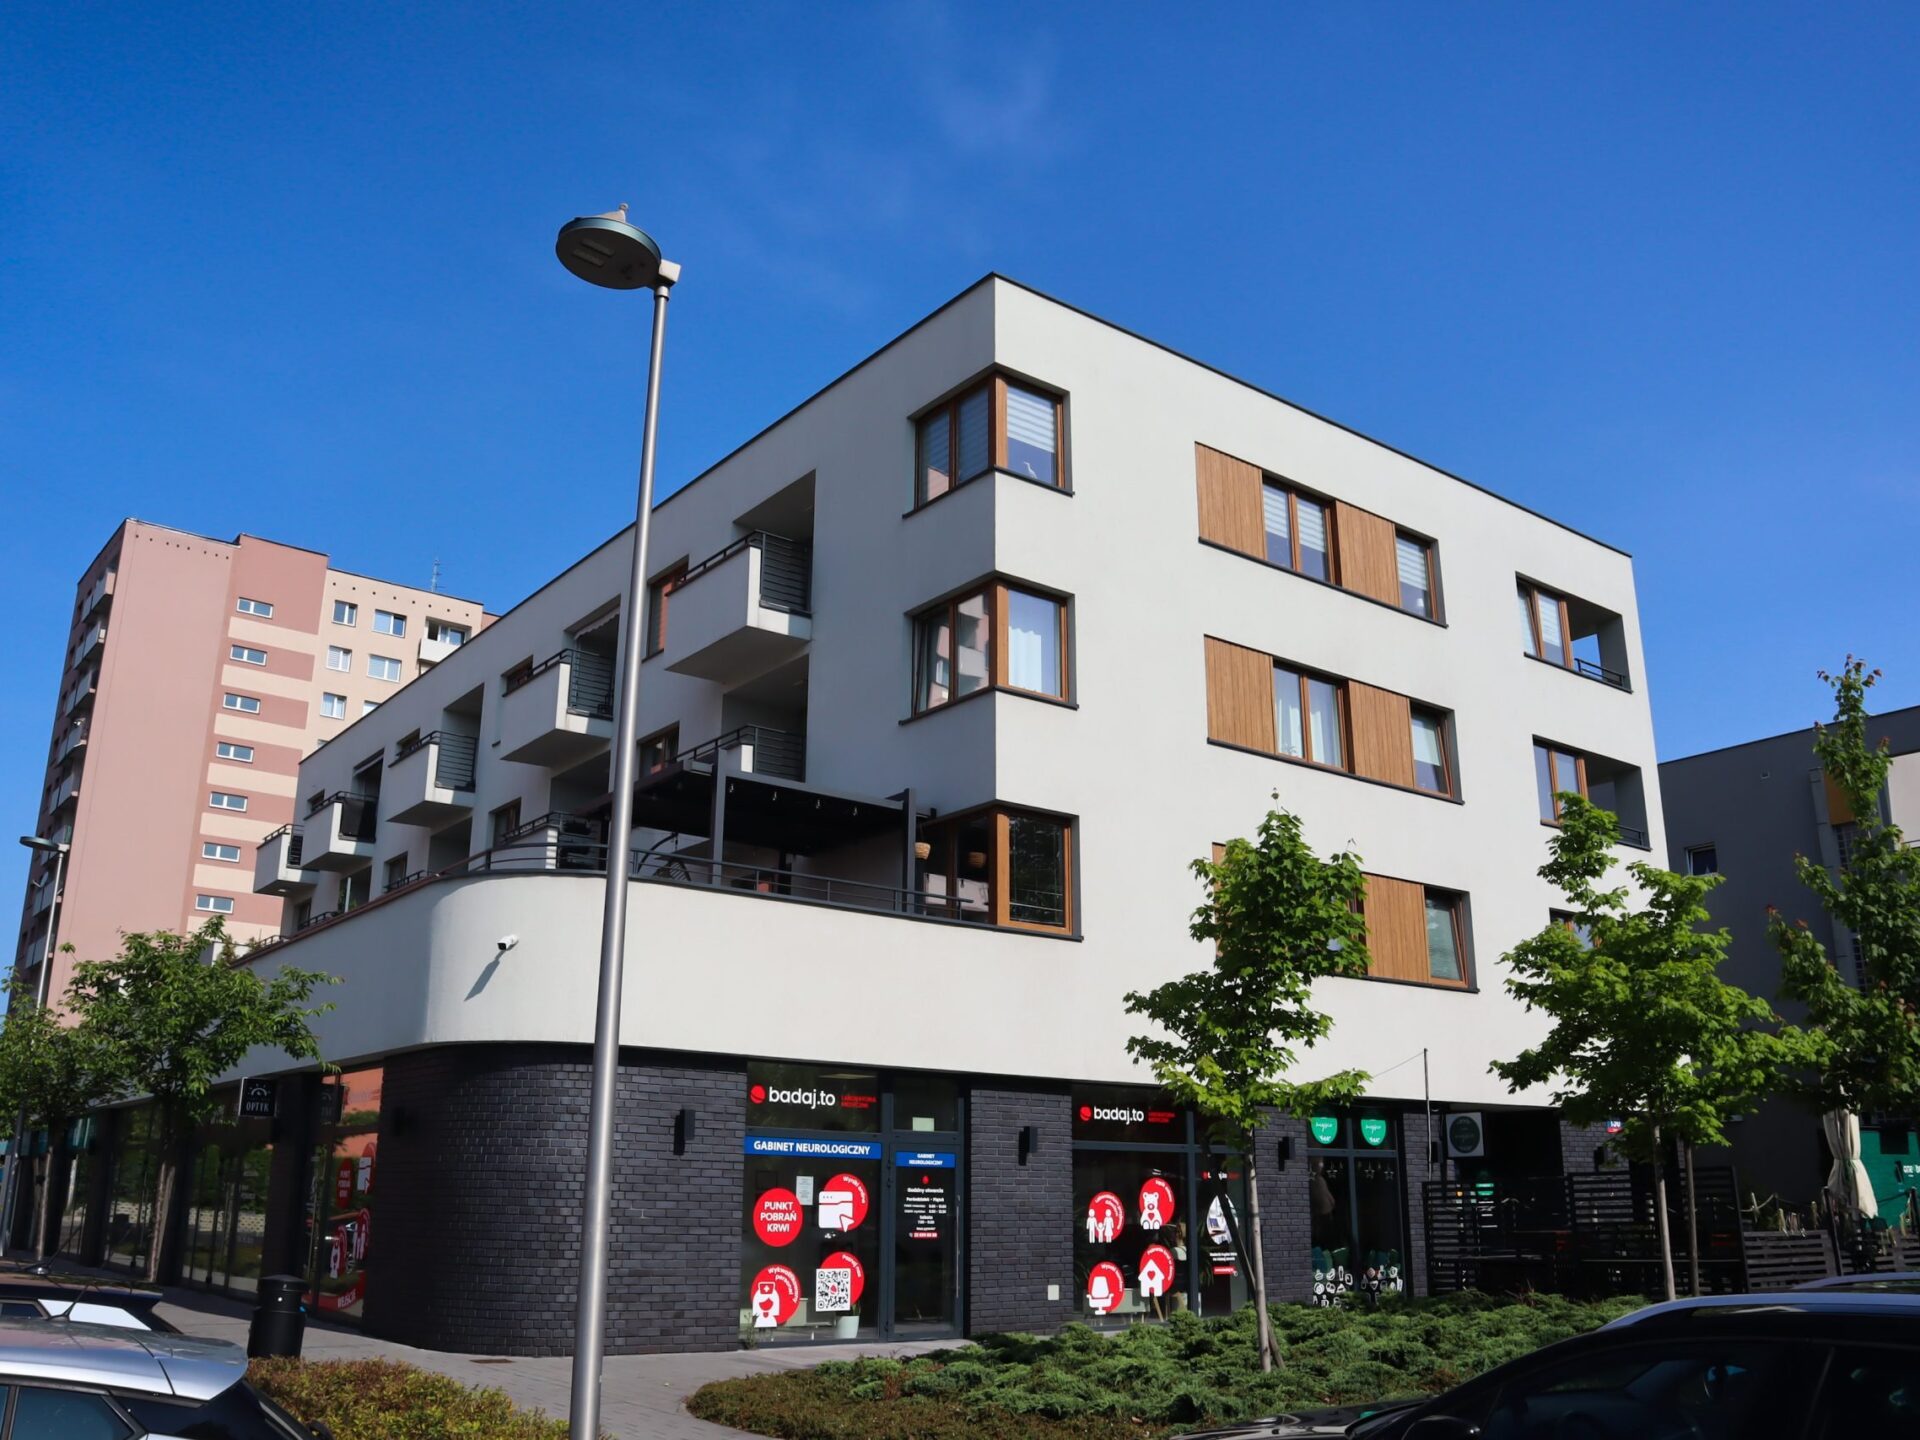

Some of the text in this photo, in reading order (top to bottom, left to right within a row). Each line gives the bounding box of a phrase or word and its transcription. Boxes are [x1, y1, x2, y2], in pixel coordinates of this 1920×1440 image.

[769, 1086, 836, 1109] badaj.to
[1093, 1106, 1144, 1125] badaj.to
[753, 1140, 870, 1155] GABINET NEUROLOGICZNY
[764, 1201, 793, 1210] PUNKT
[760, 1211, 797, 1221] POBRAŃ
[766, 1223, 790, 1232] KRWI
